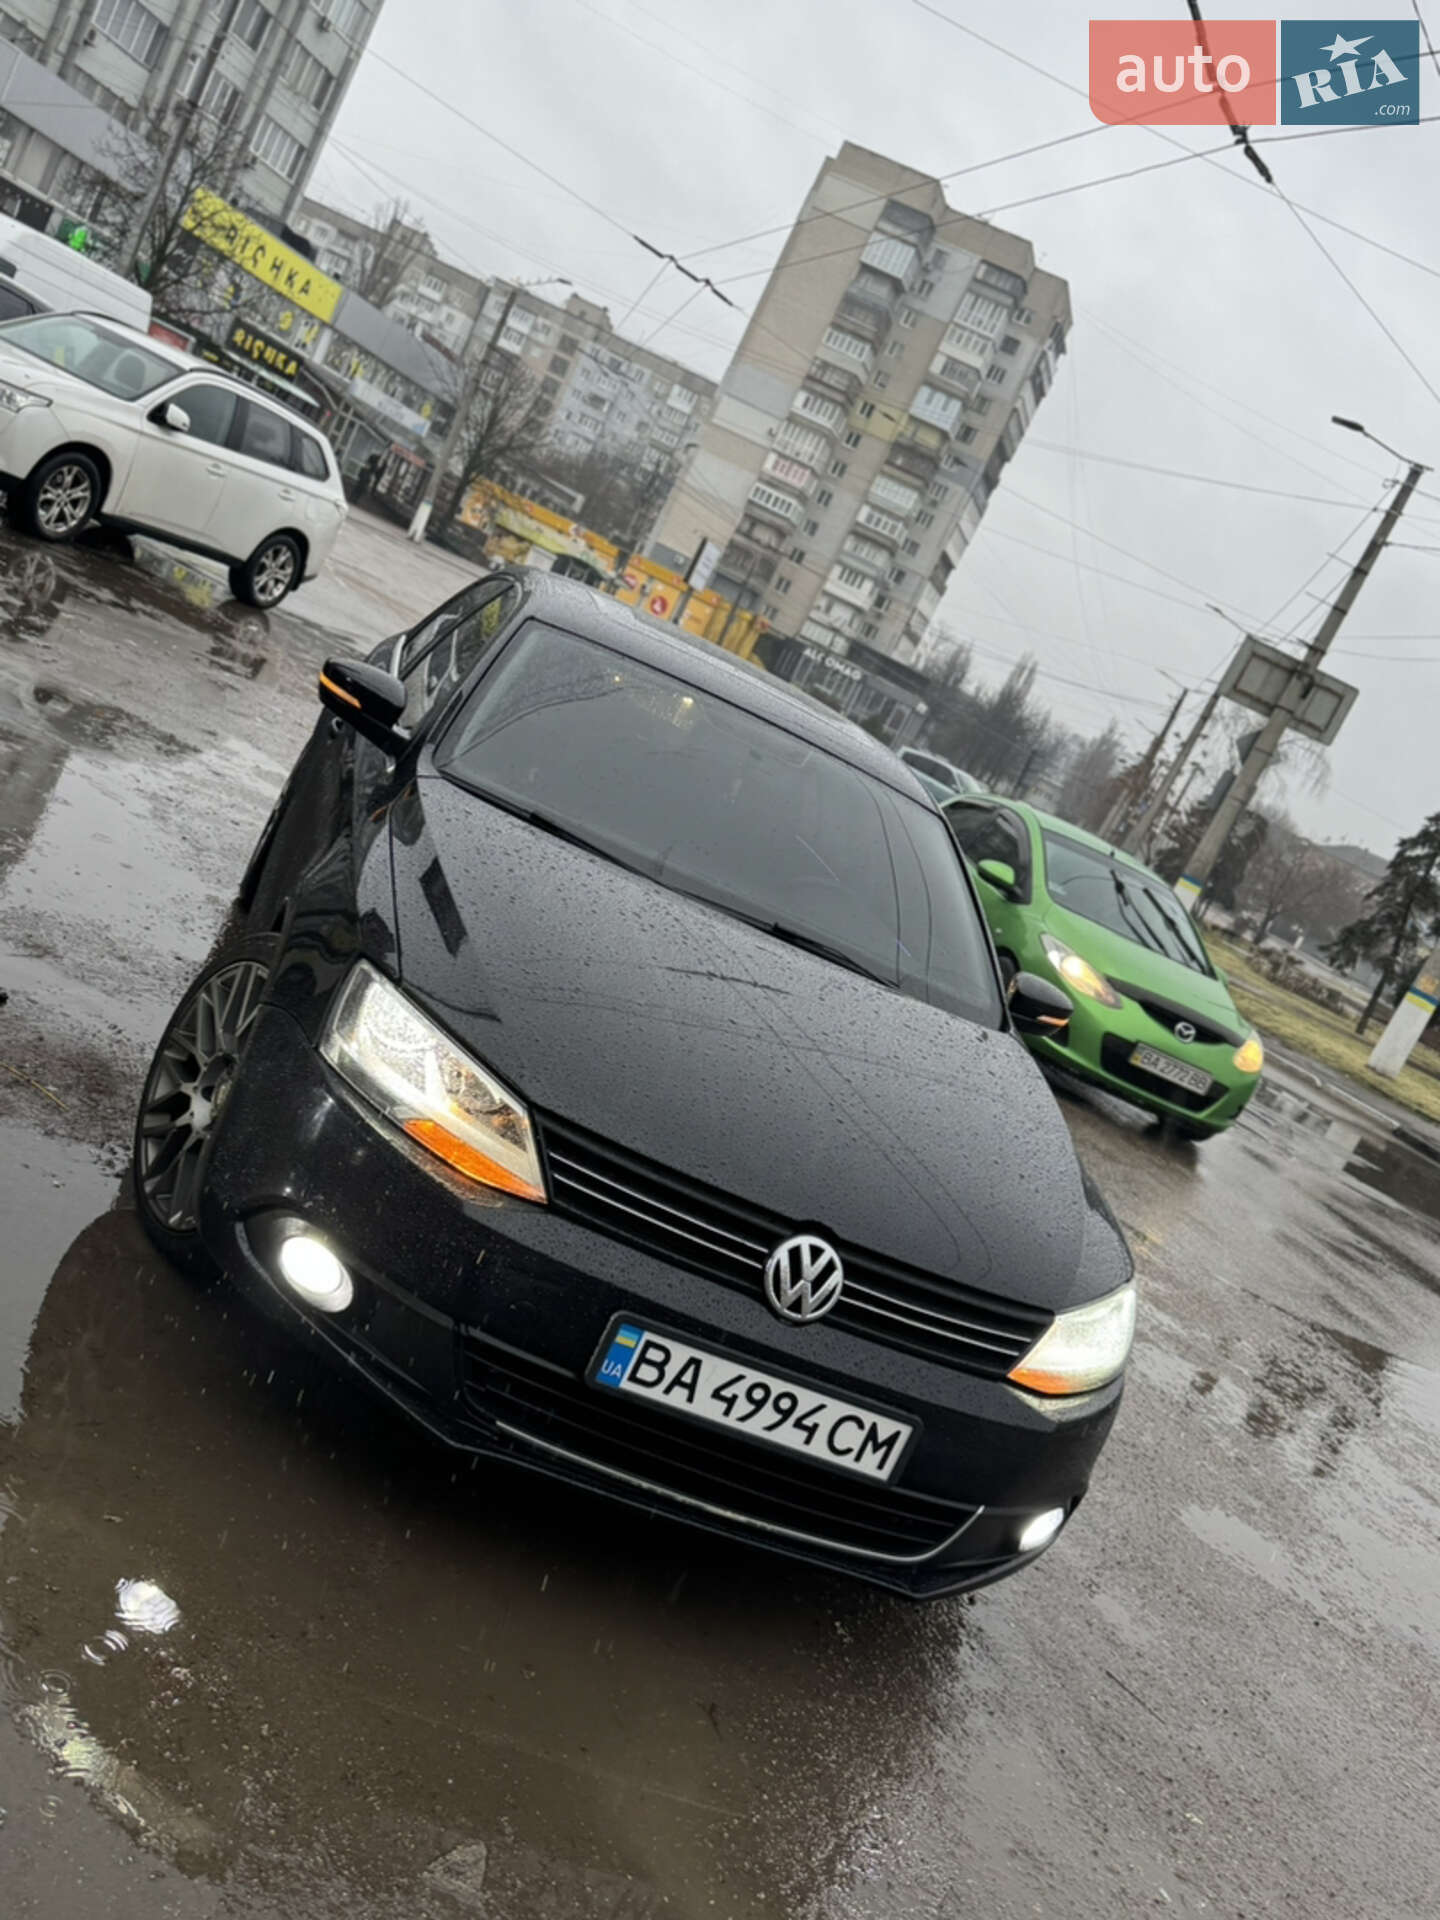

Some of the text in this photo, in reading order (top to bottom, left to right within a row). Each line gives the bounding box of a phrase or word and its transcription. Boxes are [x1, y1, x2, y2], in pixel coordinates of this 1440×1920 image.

[601, 1358, 625, 1380] UA
[627, 1338, 902, 1471] BA 4994 CM
